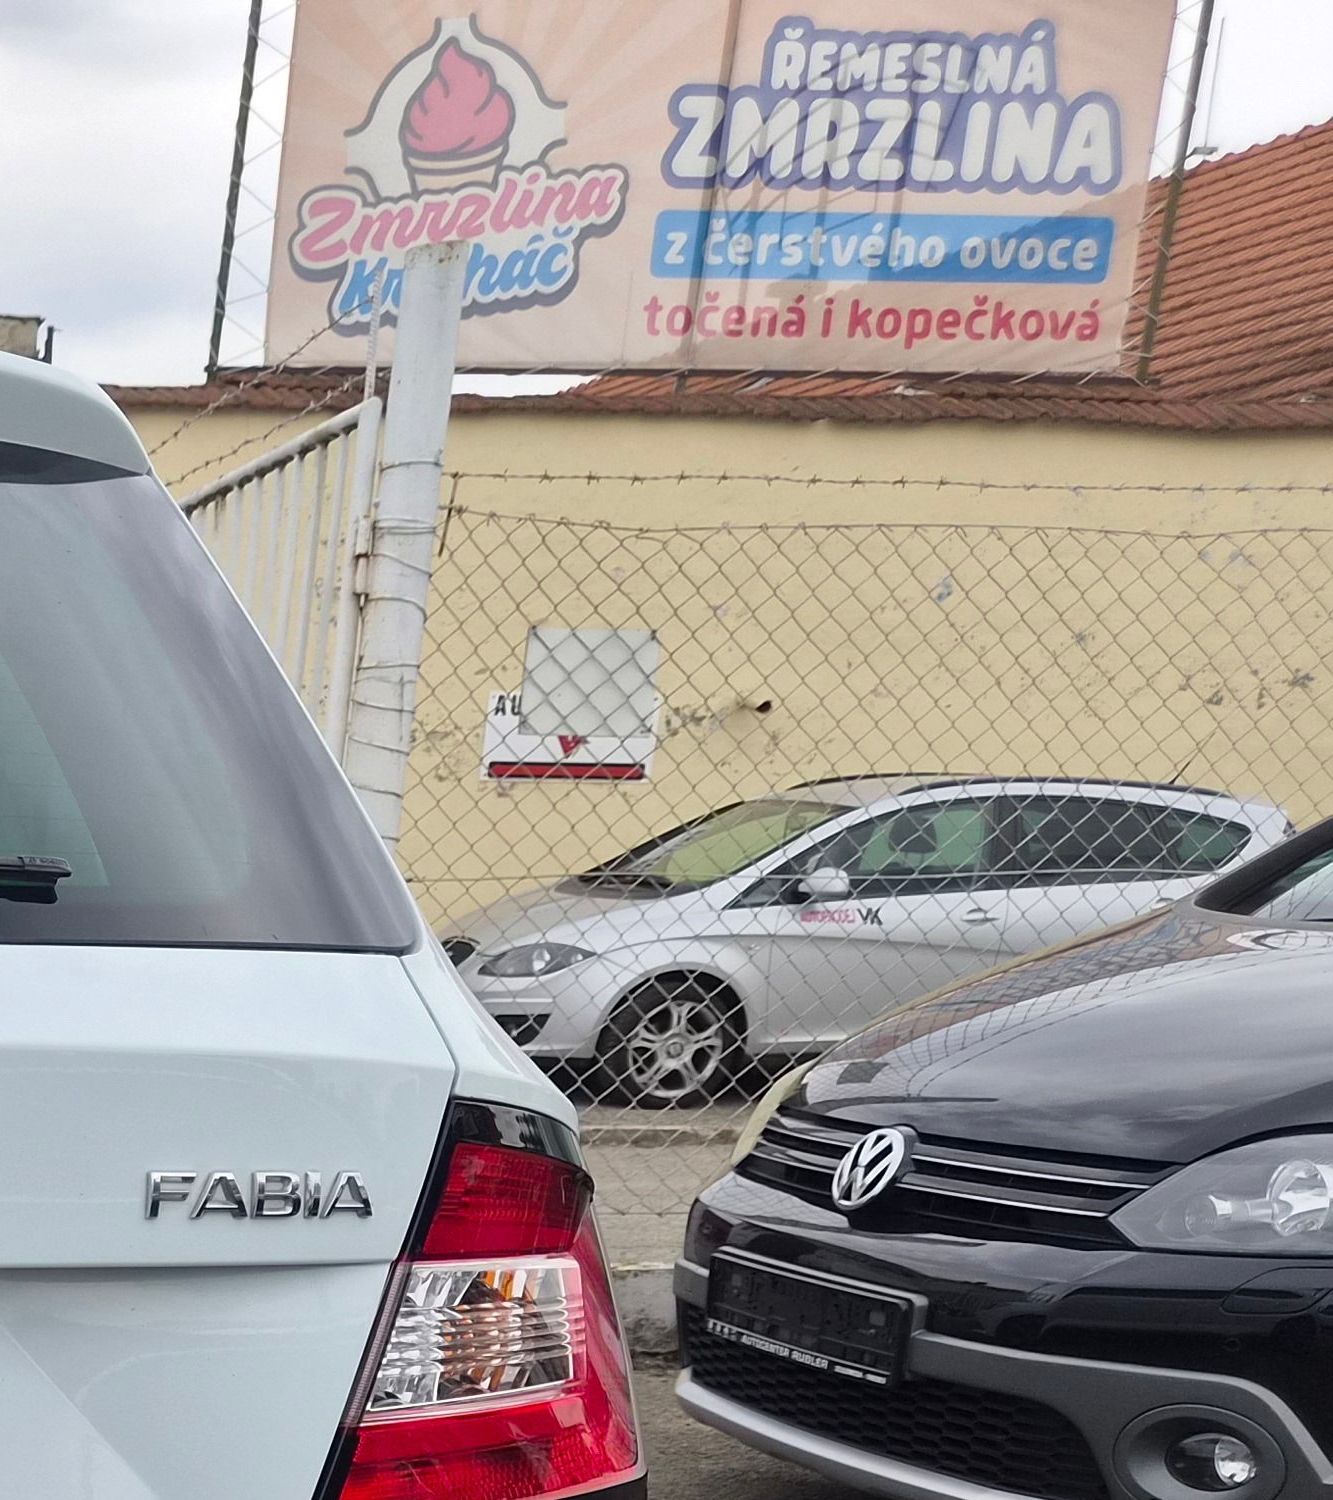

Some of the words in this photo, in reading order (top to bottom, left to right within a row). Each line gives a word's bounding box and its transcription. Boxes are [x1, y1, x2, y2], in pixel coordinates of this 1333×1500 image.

[770, 27, 1048, 95] ŘEMESLNÁ
[670, 94, 1113, 185] ZMRZLINA
[299, 172, 620, 263] Zmrzlina
[663, 231, 688, 265] z
[702, 218, 946, 270] čerstvého
[959, 236, 1099, 272] ovoce
[644, 290, 807, 340] točená
[821, 298, 836, 339] i
[846, 295, 1101, 350] kopečková
[144, 1170, 373, 1219] FABIA
